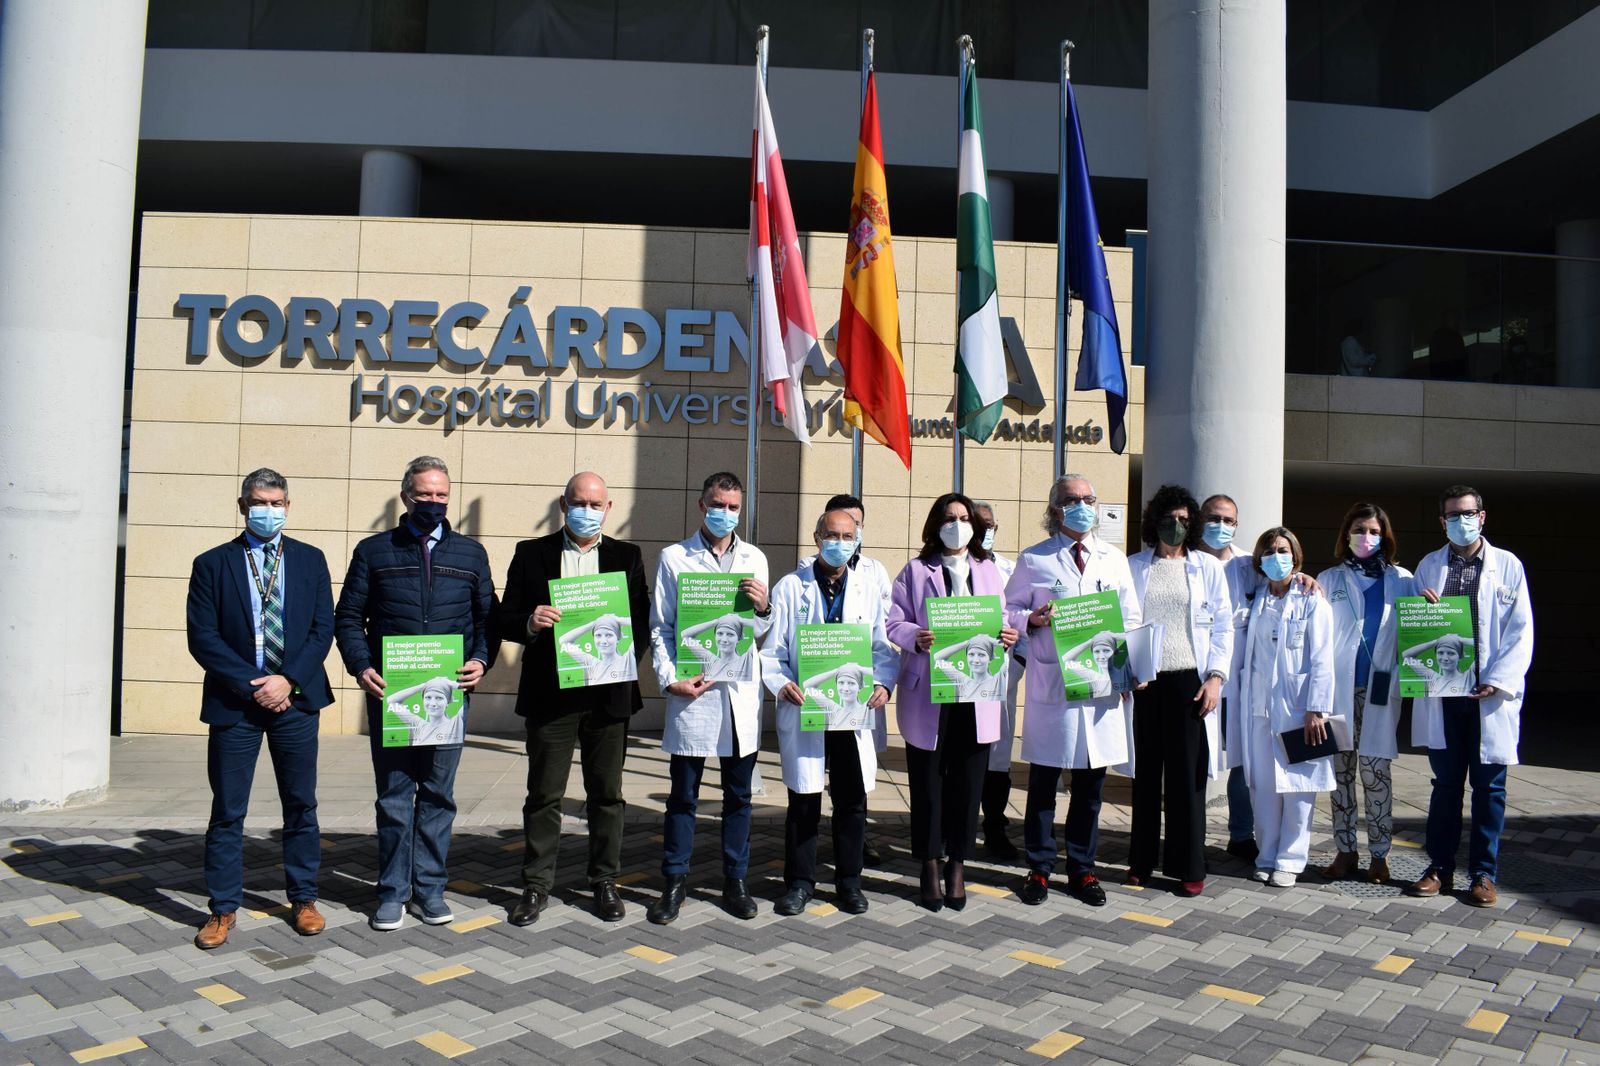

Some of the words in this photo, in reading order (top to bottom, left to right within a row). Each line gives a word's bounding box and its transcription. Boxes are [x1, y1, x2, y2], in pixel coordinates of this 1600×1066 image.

[178, 286, 845, 377] TORRECÁRDEN
[582, 580, 605, 588] premio
[555, 595, 600, 605] posibilidades
[682, 592, 725, 600] posibilidades
[1078, 599, 1099, 608] premio
[1055, 613, 1095, 625] posibilidades
[1401, 614, 1443, 622] posibilidades
[705, 639, 712, 648] 9
[958, 661, 964, 670] 9
[1427, 659, 1433, 667] 9
[827, 689, 834, 698] 9
[413, 704, 420, 713] 9
